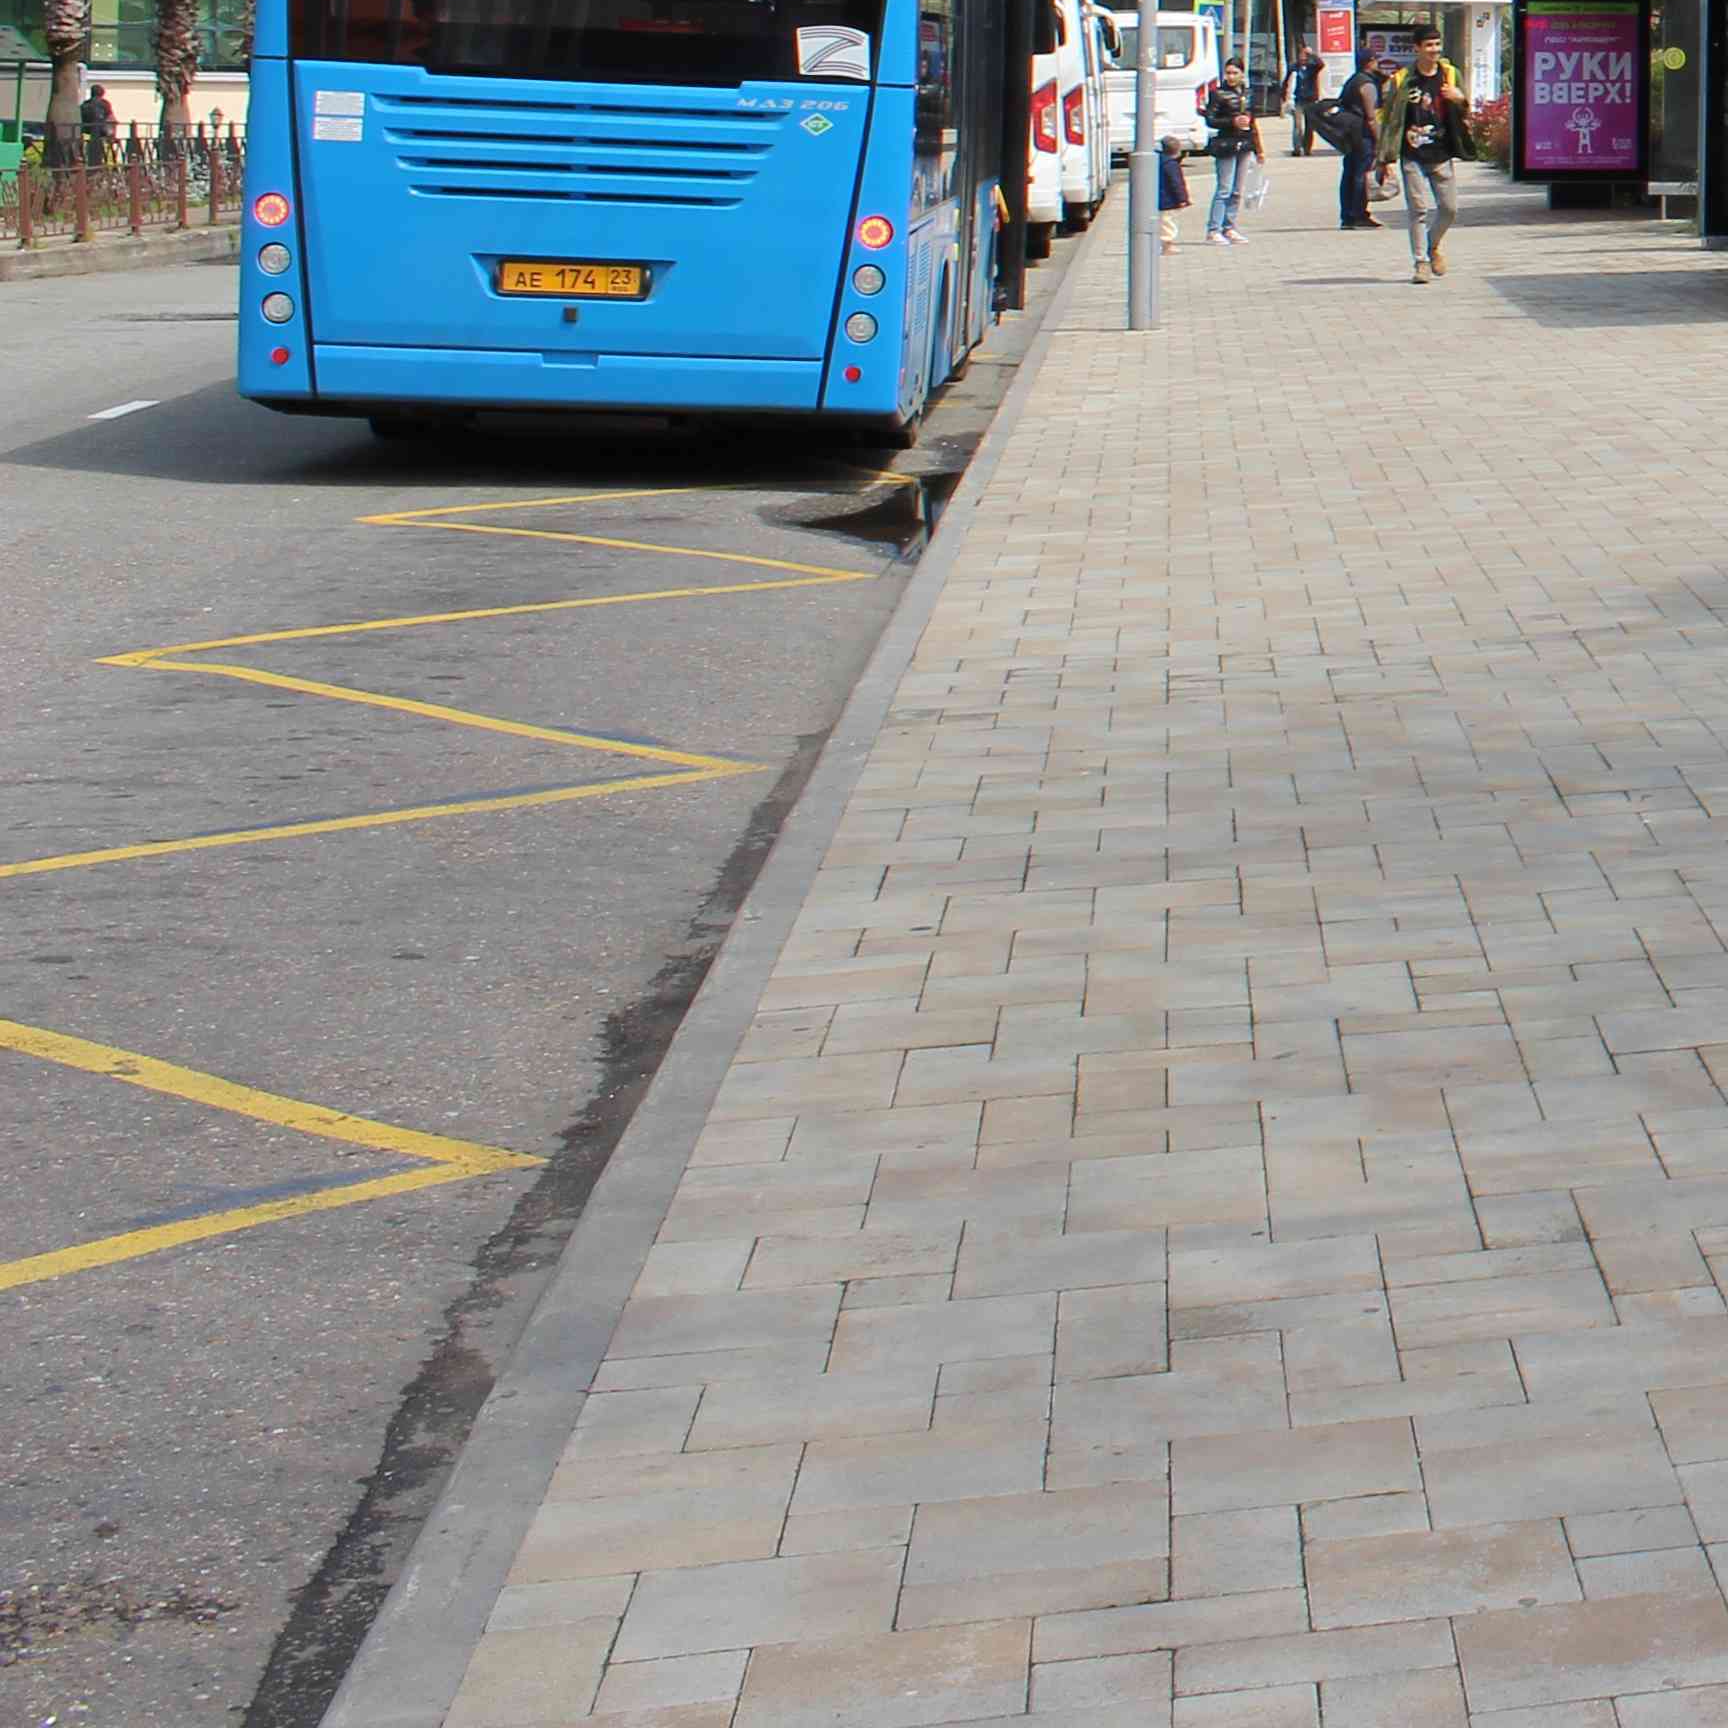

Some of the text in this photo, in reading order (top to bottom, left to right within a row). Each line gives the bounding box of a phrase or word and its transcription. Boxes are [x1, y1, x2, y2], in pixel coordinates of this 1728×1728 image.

[1533, 51, 1633, 81] РУКИ
[555, 268, 596, 290] 174
[610, 268, 632, 286] 23
